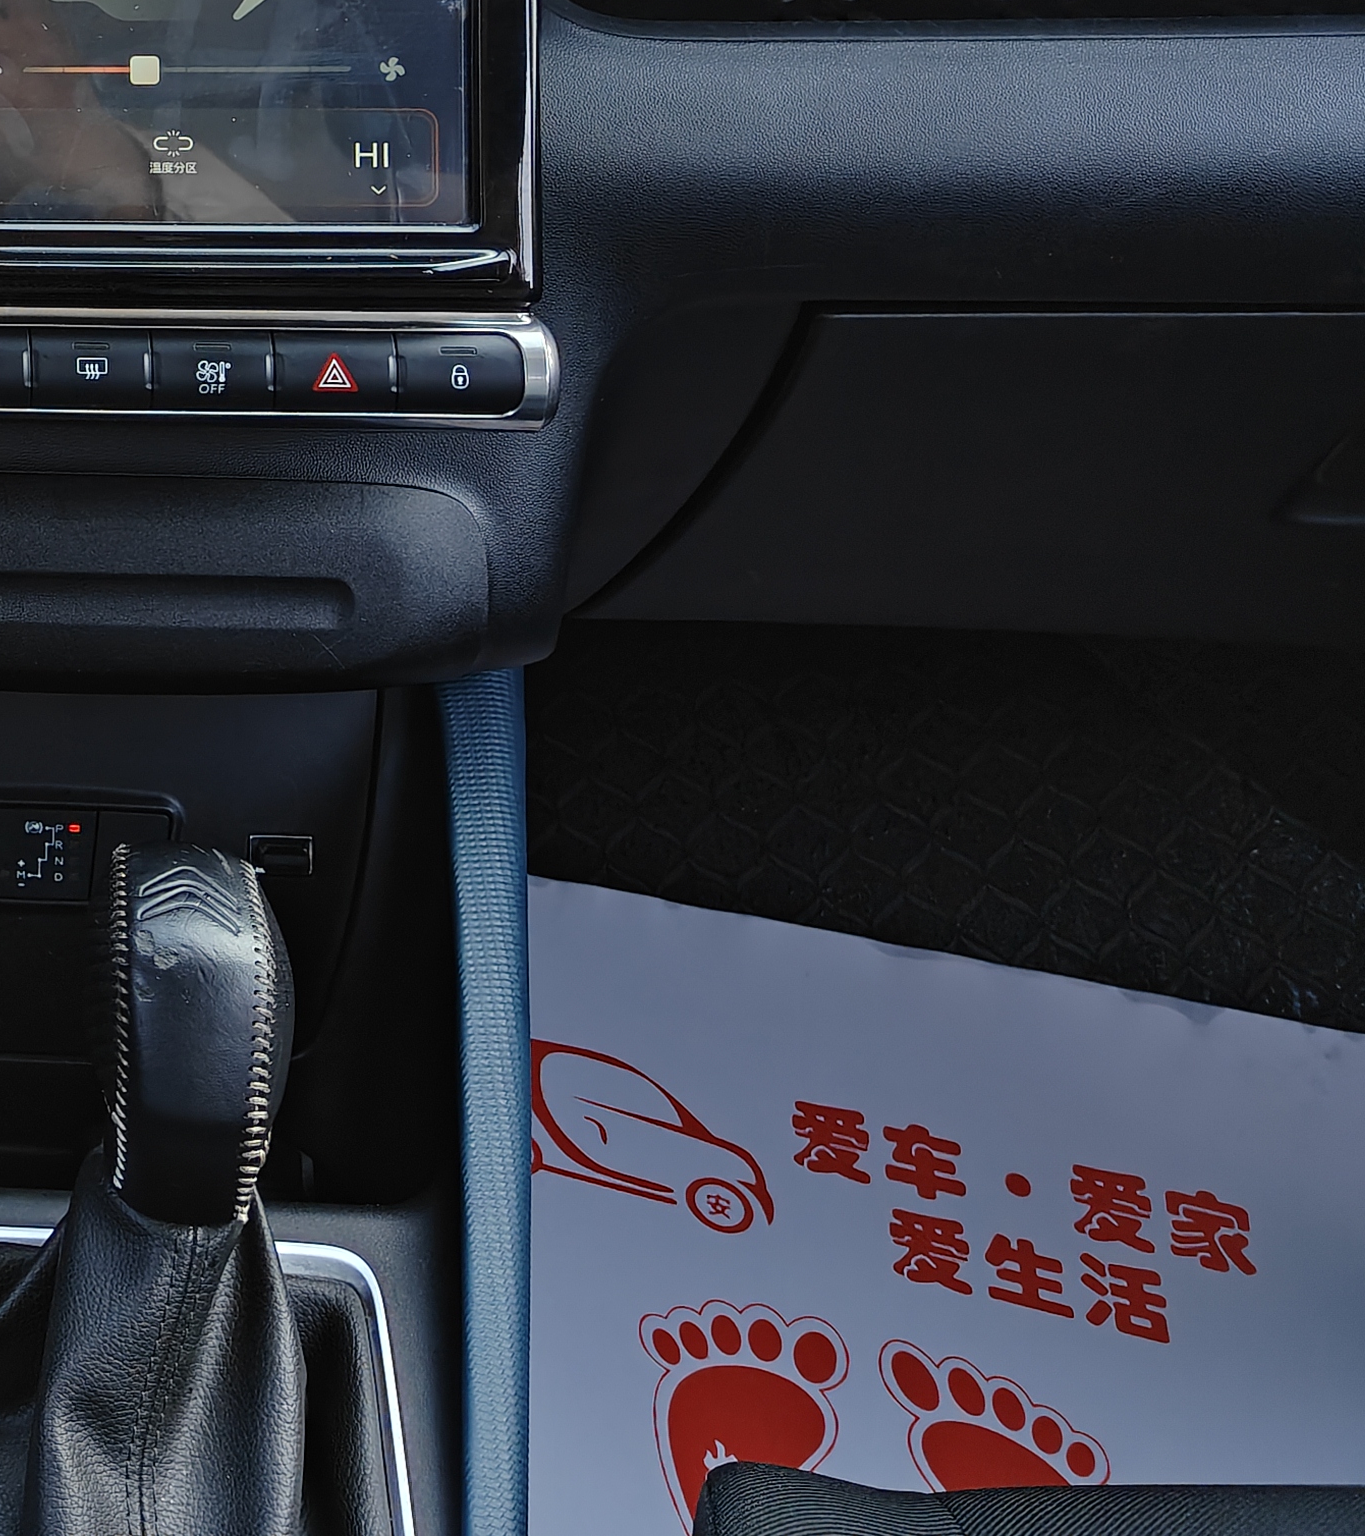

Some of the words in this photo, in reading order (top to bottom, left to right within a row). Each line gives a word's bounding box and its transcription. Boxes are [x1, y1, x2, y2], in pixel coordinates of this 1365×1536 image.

[354, 142, 389, 168] HI
[149, 161, 198, 175] 温度分区
[198, 383, 226, 395] OFF
[55, 824, 64, 833] P
[54, 841, 64, 851] R
[54, 857, 64, 866] N
[16, 870, 26, 879] M
[54, 873, 64, 882] D
[888, 1208, 1171, 1344] 爱生活
